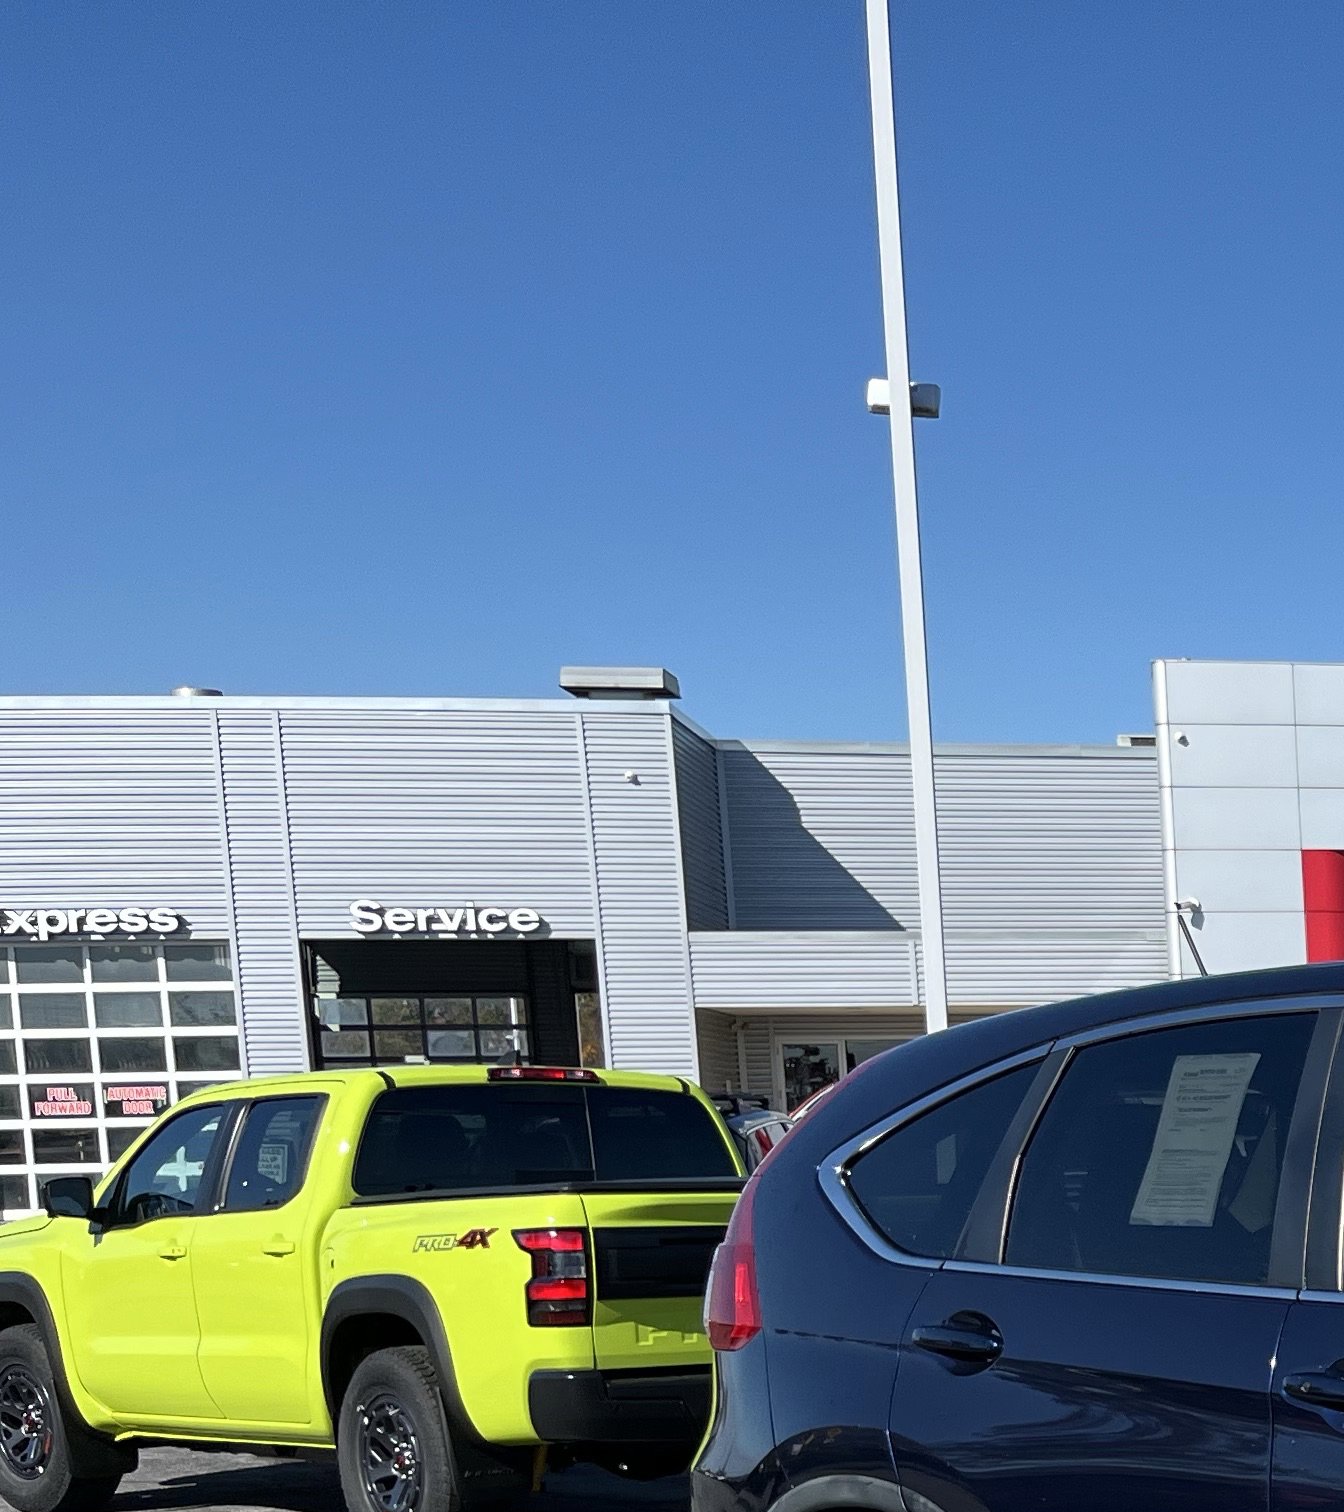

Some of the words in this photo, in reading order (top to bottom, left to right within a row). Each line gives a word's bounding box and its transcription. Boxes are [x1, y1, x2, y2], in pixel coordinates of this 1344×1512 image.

[349, 899, 541, 933] Service
[0, 907, 179, 941] xpress
[46, 1087, 78, 1101] PULL
[106, 1086, 167, 1101] AUTOMATIC
[34, 1101, 92, 1116] FORWARD
[122, 1101, 155, 1115] DOOR
